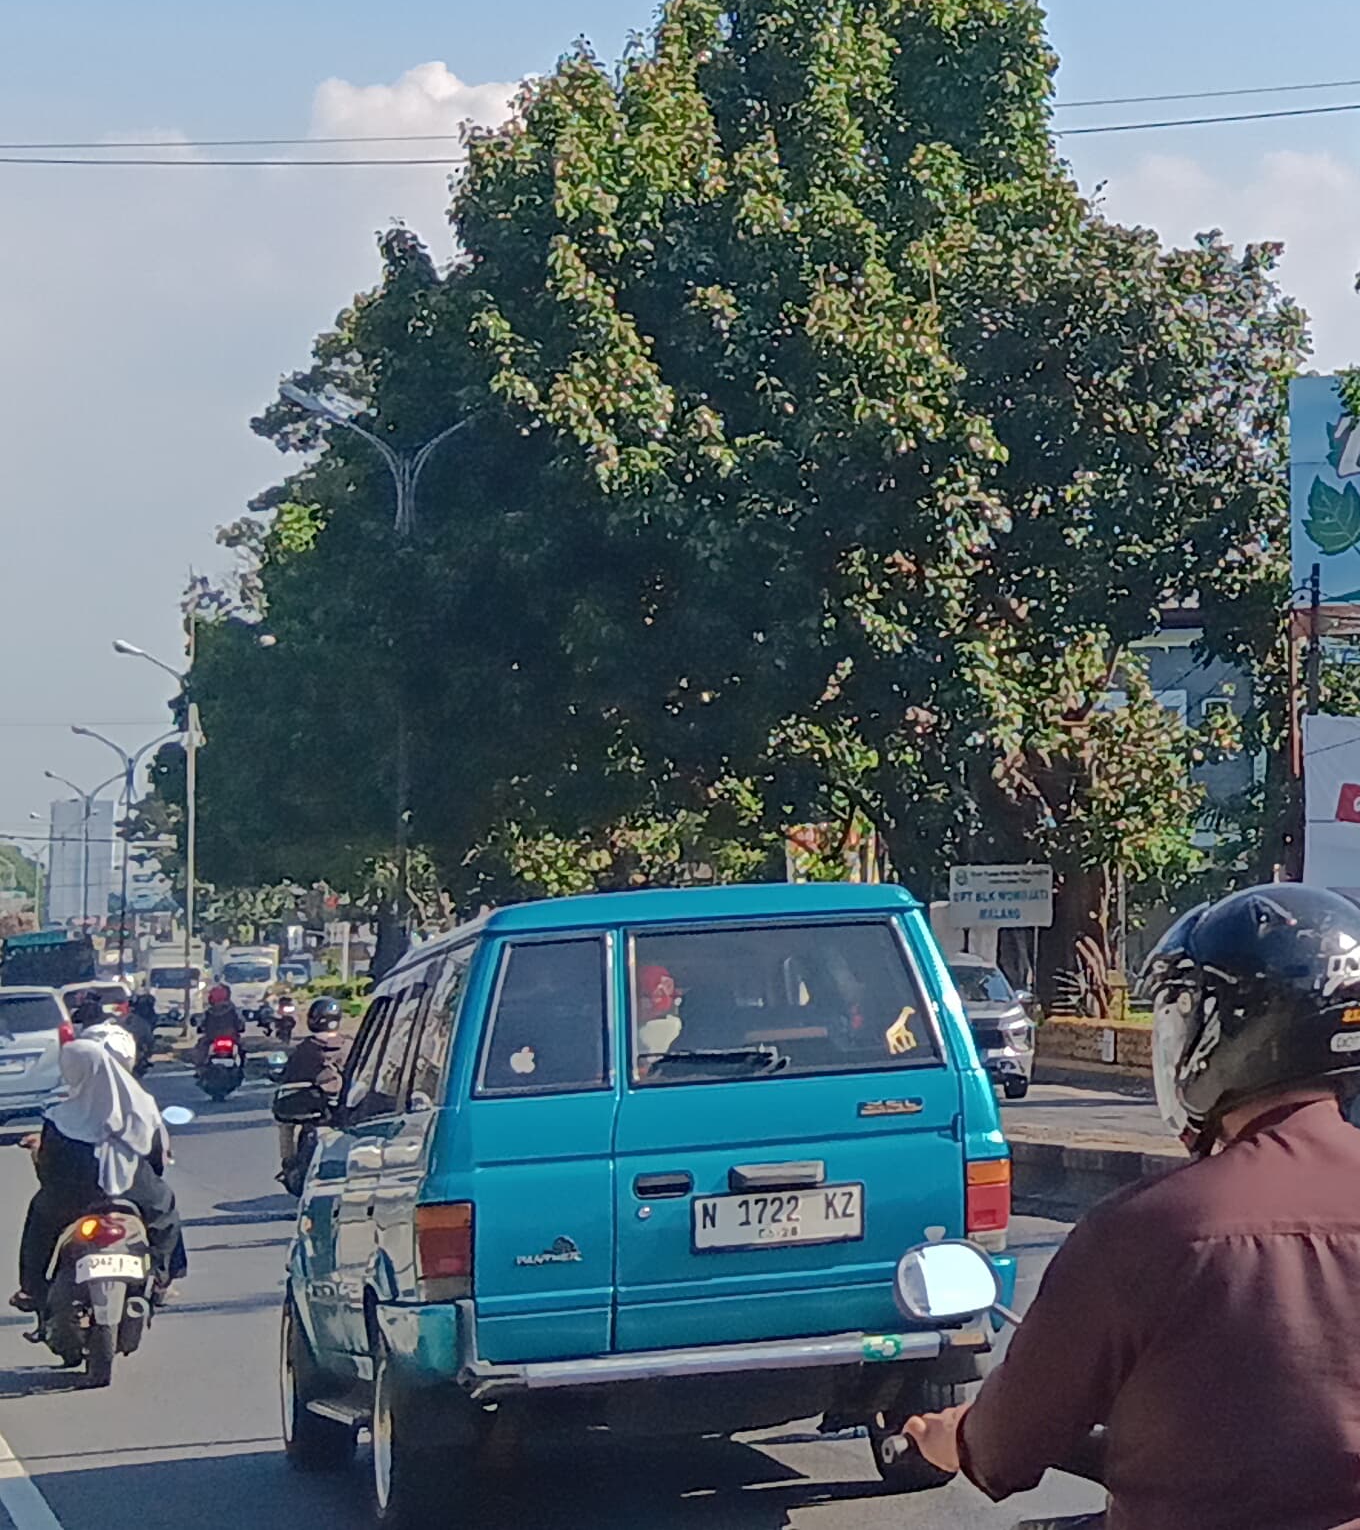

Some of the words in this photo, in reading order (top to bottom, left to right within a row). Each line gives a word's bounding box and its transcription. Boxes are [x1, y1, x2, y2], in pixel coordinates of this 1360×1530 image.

[702, 1202, 717, 1229] N
[738, 1195, 801, 1226] 1722
[824, 1192, 855, 1220] KZ
